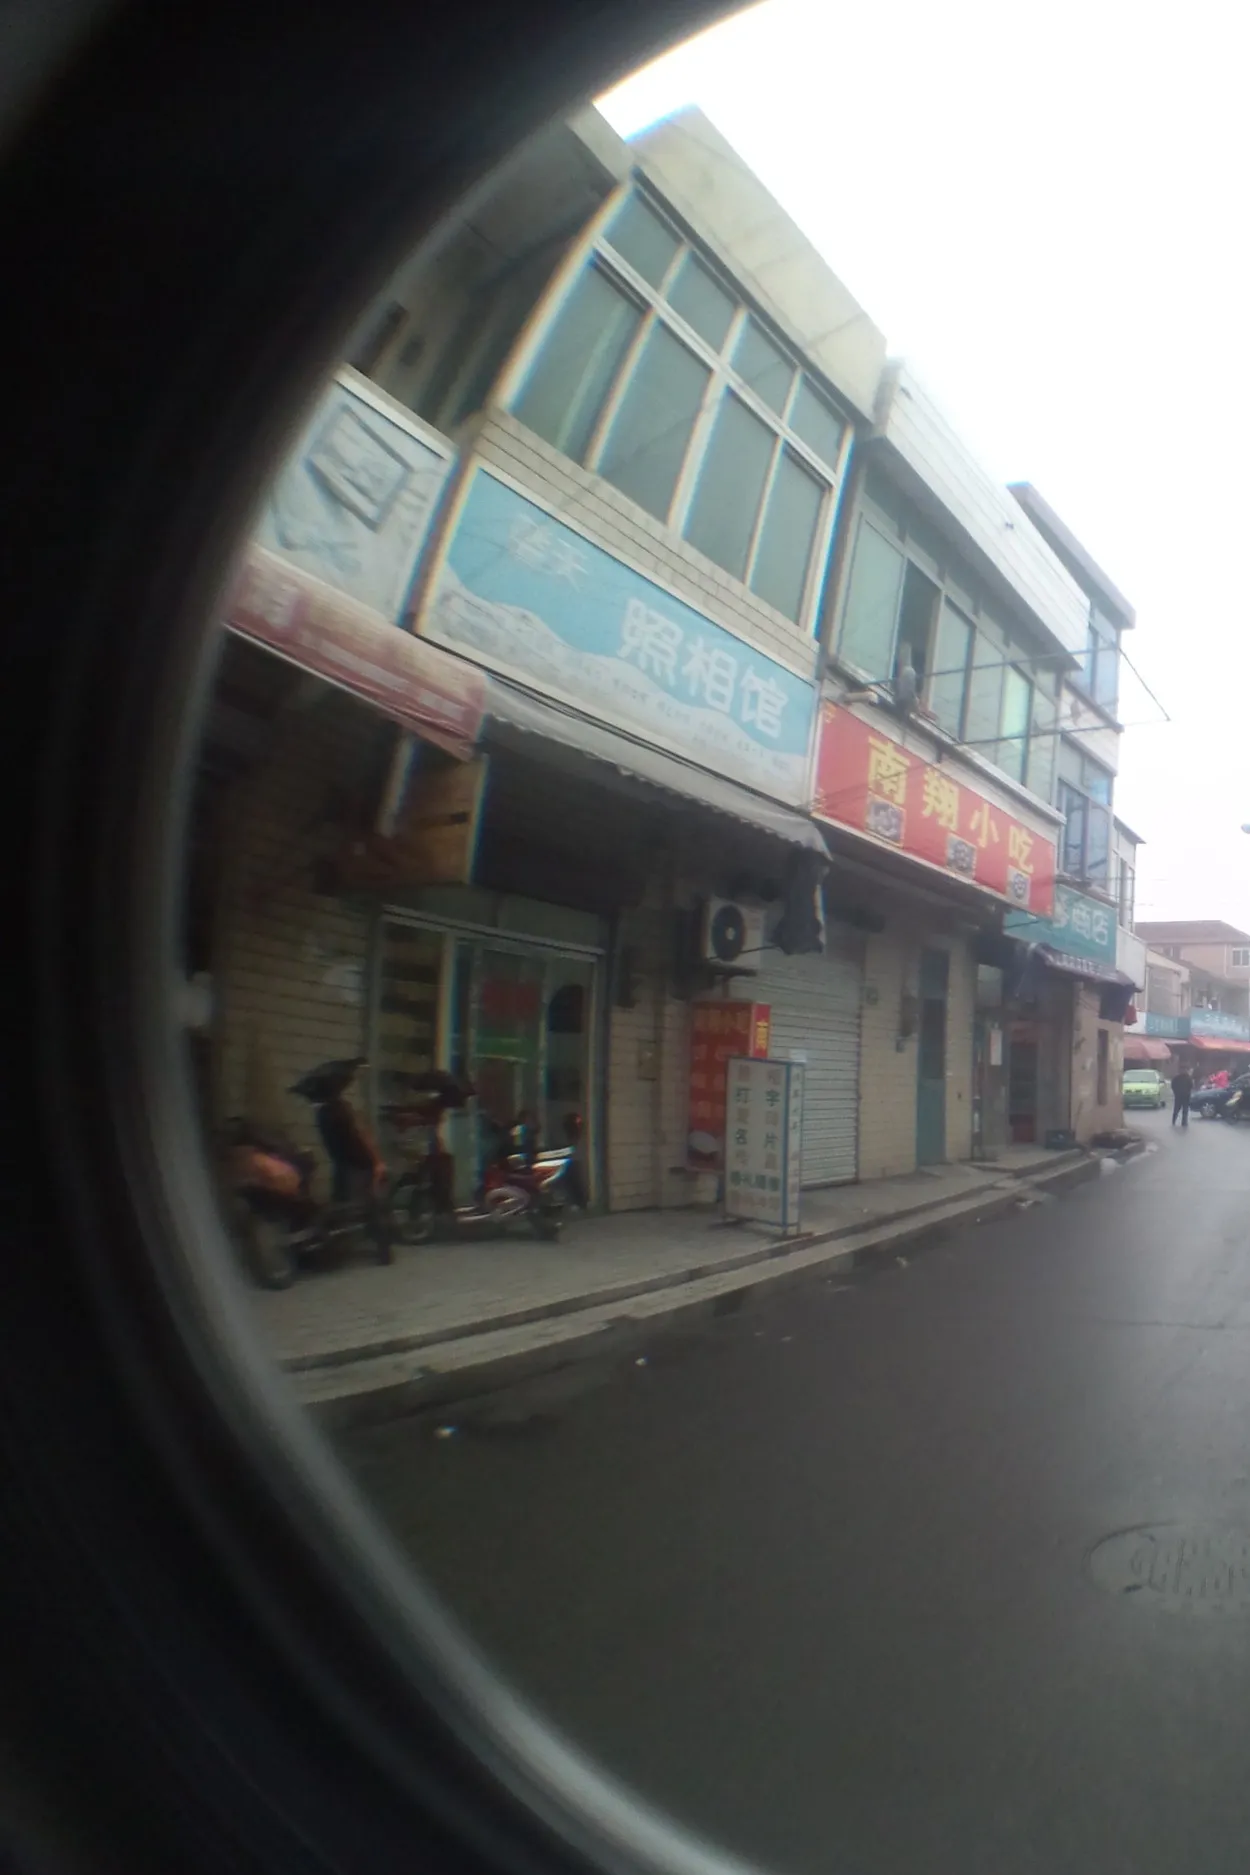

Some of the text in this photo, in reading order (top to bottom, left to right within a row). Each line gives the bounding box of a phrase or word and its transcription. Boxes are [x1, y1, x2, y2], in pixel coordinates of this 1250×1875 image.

[617, 597, 789, 739] 照相馆
[867, 735, 1034, 874] 南翔小吃
